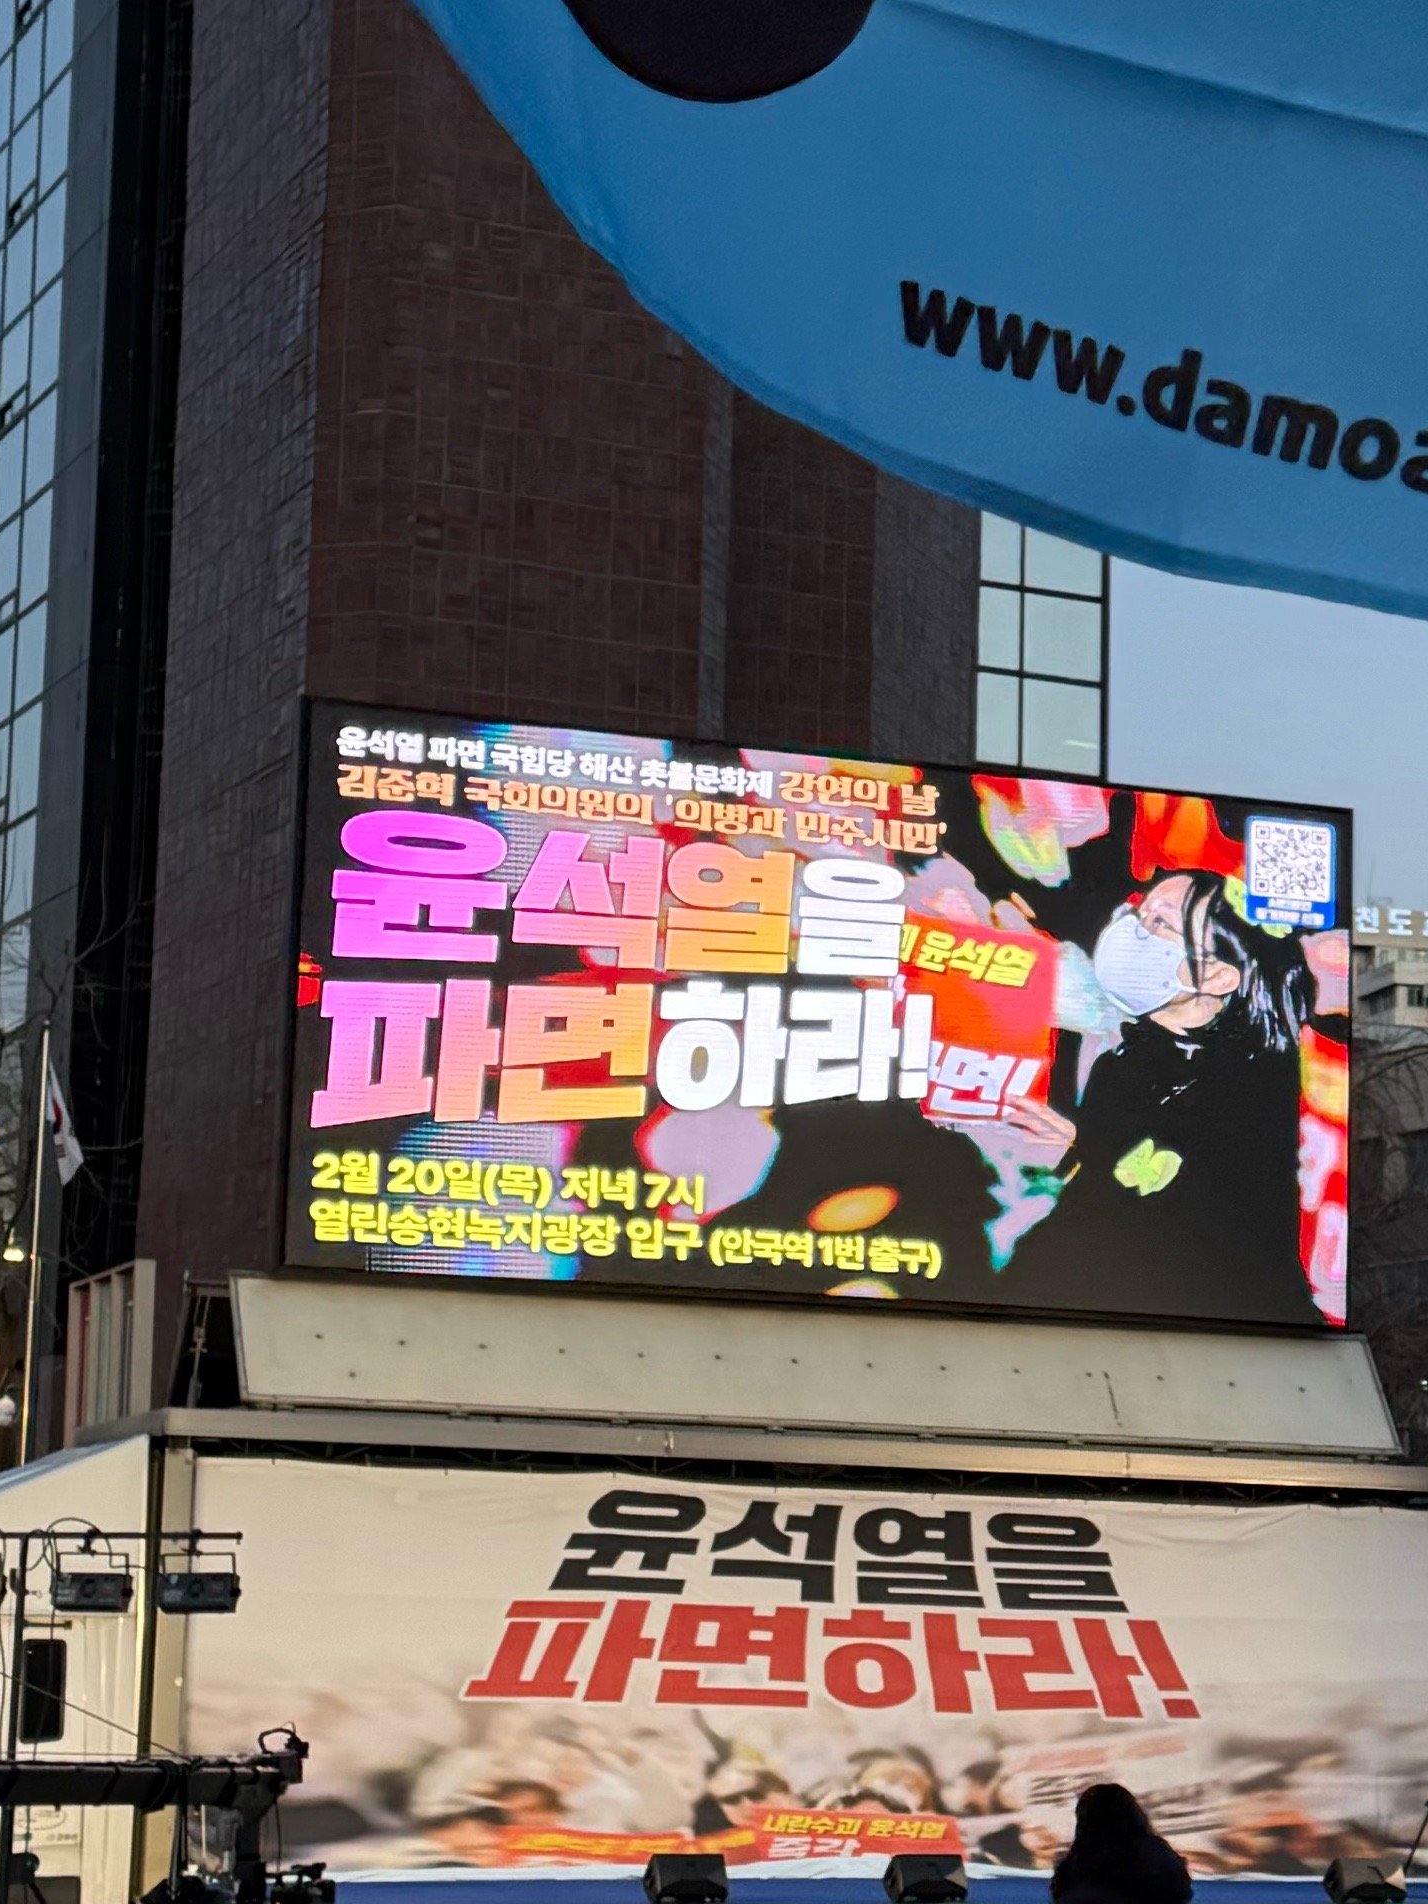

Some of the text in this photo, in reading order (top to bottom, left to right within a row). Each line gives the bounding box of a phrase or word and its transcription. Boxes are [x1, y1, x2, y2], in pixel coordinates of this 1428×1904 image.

[336, 725, 423, 763] 윤석열
[428, 737, 485, 770] 파면
[490, 743, 576, 778] 국힘당
[579, 752, 636, 785] 해산
[779, 770, 890, 813] 강연의
[900, 783, 940, 816] 날
[336, 764, 456, 807] 김준혁
[463, 776, 654, 826] 국회의원의
[330, 809, 908, 977] 윤석열을
[915, 929, 1038, 988] 윤석열
[310, 979, 934, 1129] 파면하라!
[927, 1040, 1044, 1117] 면!
[311, 1150, 706, 1215] 2월 20일(목) 저녁 7시
[309, 1198, 943, 1279] 열린송현녹지광장 입구 (안국역 1번 출구)
[548, 1489, 1129, 1613] 윤석열을
[462, 1598, 1201, 1720] 파면하라!
